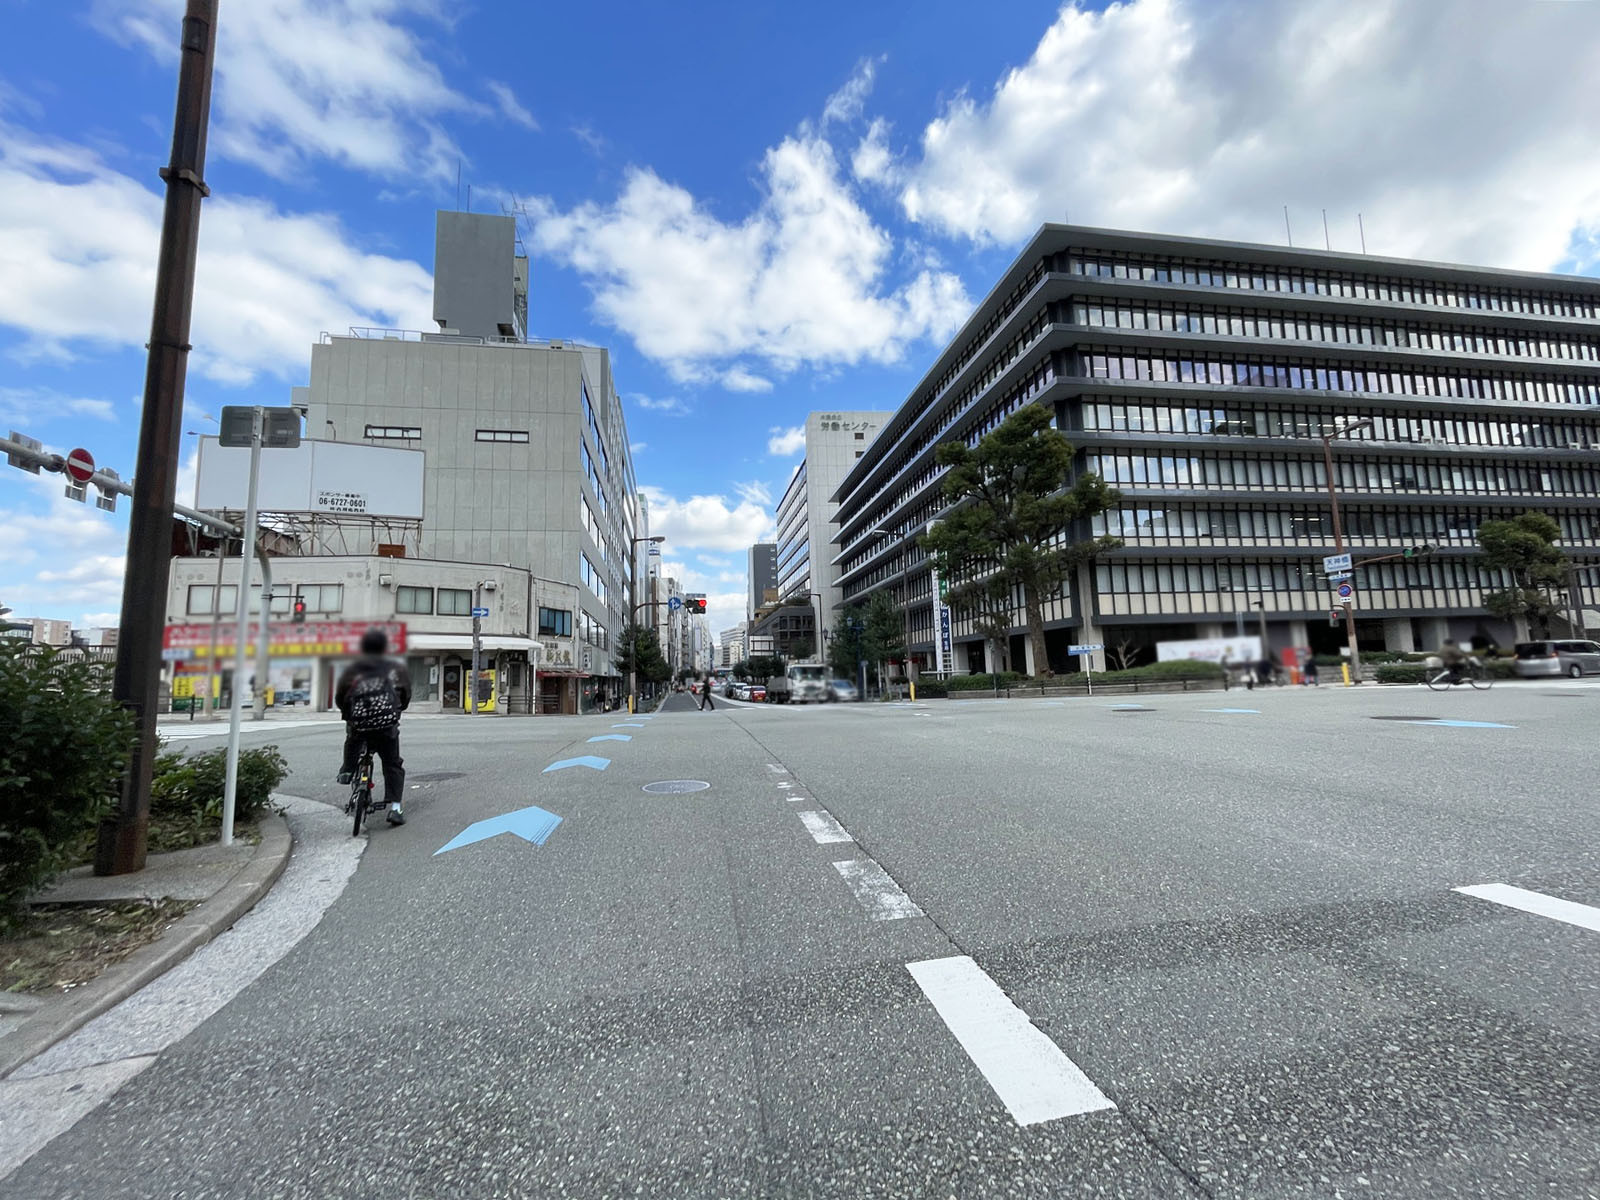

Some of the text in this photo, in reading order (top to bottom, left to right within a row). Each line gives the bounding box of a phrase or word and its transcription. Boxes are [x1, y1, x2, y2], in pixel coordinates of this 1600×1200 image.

[821, 421, 877, 431] 労働センター
[319, 497, 366, 507] 06-6727-0601
